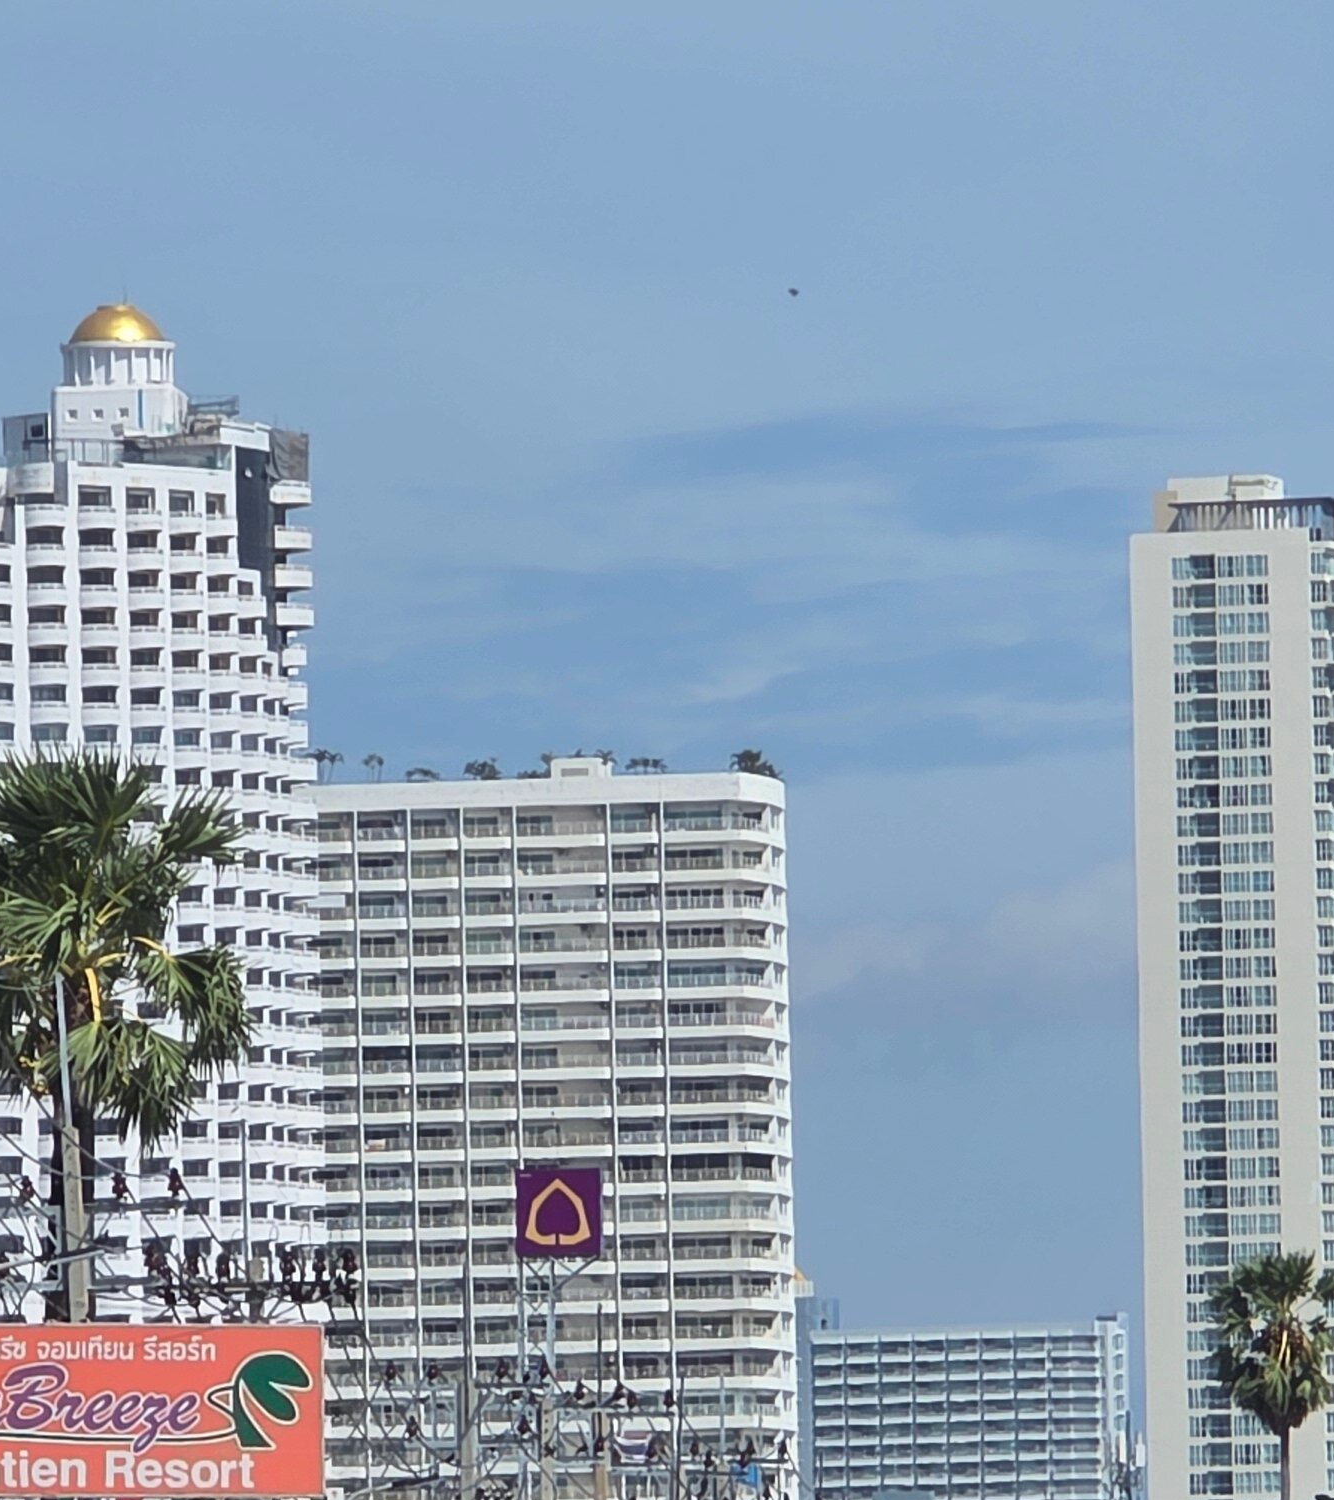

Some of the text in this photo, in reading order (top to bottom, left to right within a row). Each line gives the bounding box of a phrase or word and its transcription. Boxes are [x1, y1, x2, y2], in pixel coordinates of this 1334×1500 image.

[37, 1335, 134, 1361] จอมเทียน
[143, 1335, 216, 1361] รีสอร์ท
[106, 1452, 255, 1488] Resort
